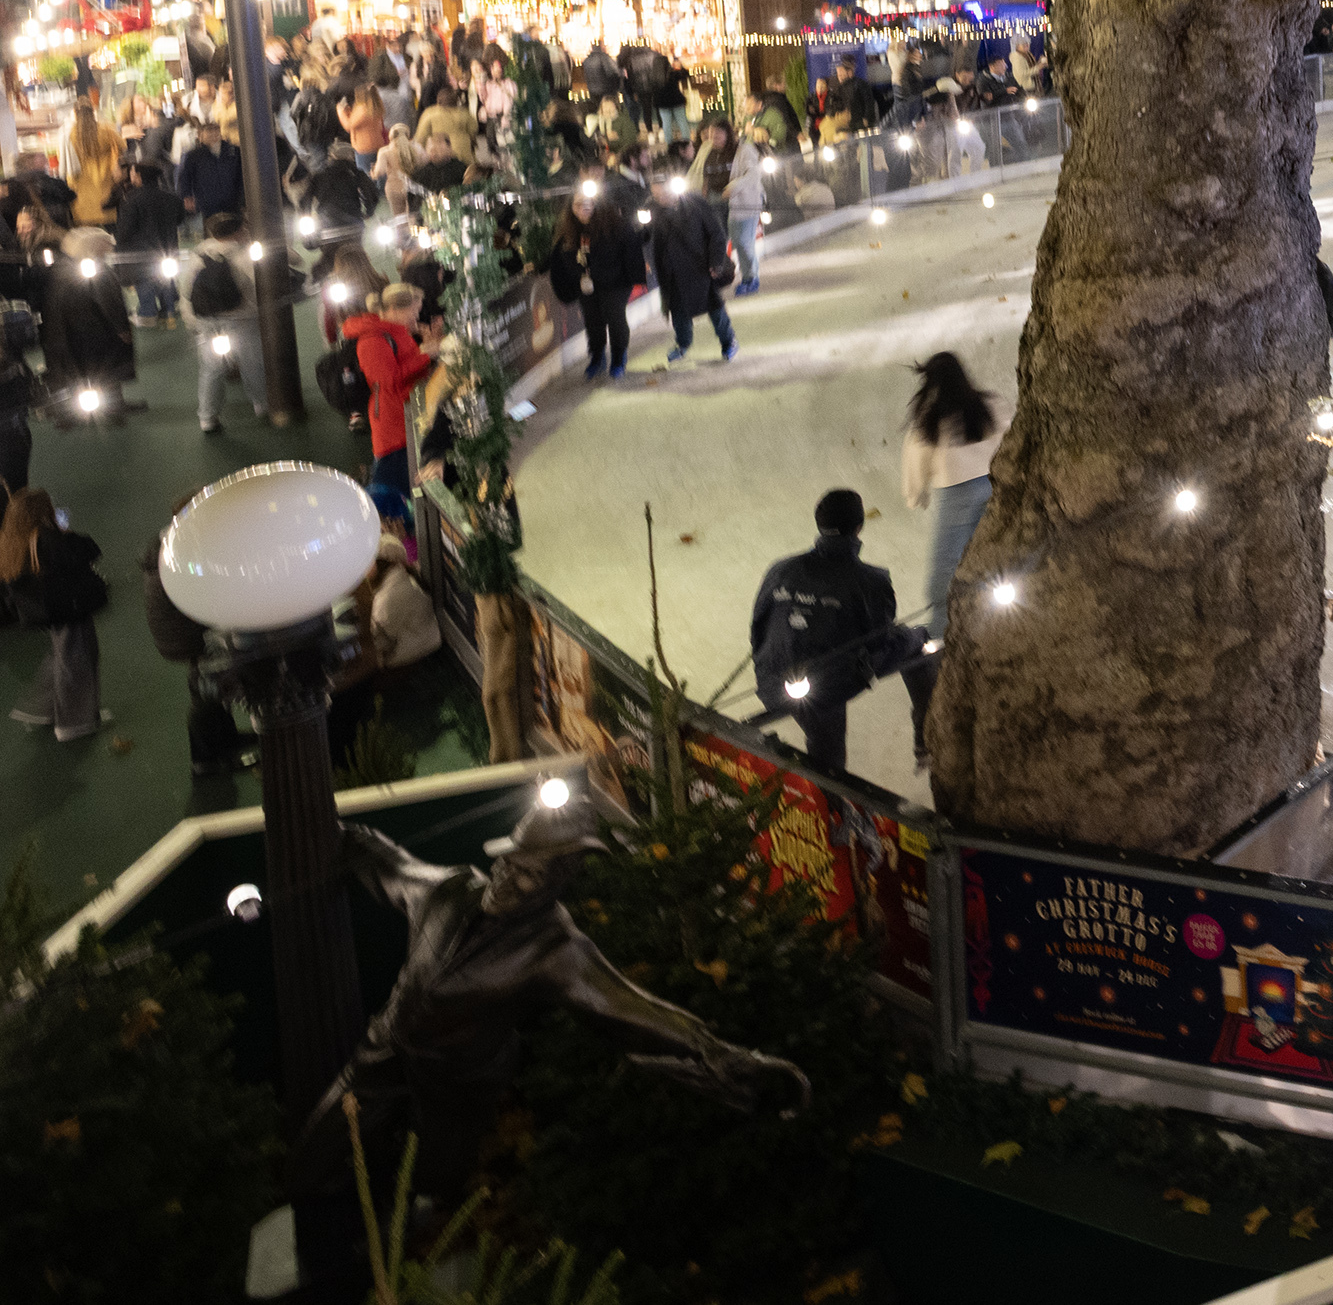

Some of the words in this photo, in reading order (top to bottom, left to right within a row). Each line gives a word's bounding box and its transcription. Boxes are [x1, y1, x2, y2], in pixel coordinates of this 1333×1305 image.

[1064, 876, 1145, 909] FATHER
[1036, 897, 1178, 944] CHRISTMAS'S
[1062, 918, 1147, 952] GROTTO
[1118, 968, 1134, 985] 24
